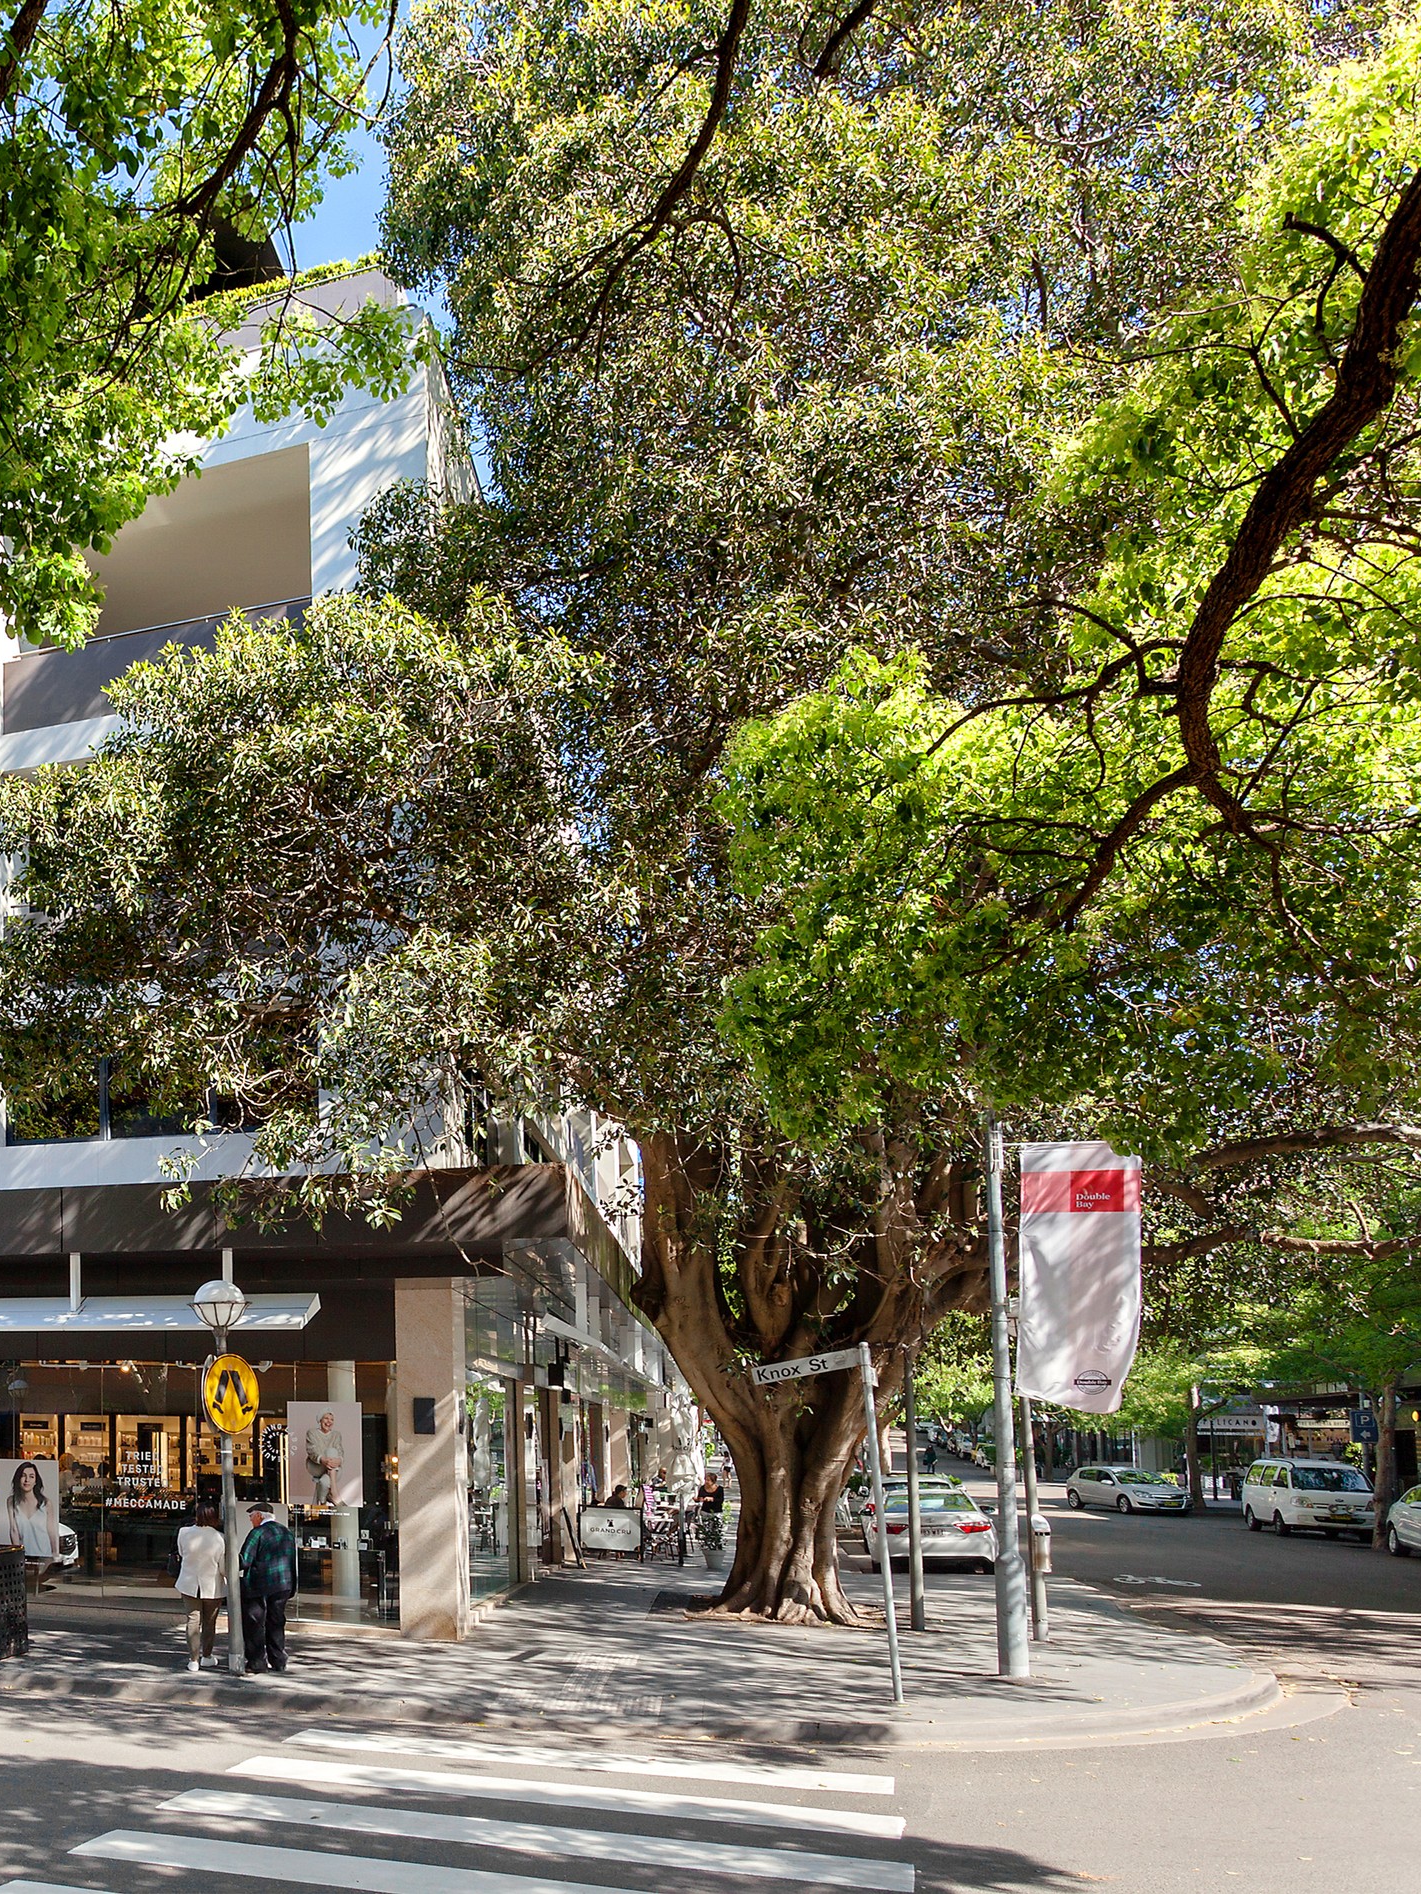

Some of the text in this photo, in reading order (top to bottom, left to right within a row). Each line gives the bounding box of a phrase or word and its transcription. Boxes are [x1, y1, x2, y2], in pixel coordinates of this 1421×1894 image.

[1075, 1192, 1111, 1201] Double
[1075, 1201, 1094, 1209] Bay
[756, 1358, 829, 1382] Knox St
[1360, 1415, 1369, 1425] P
[105, 1497, 187, 1510] #MECCAMADE
